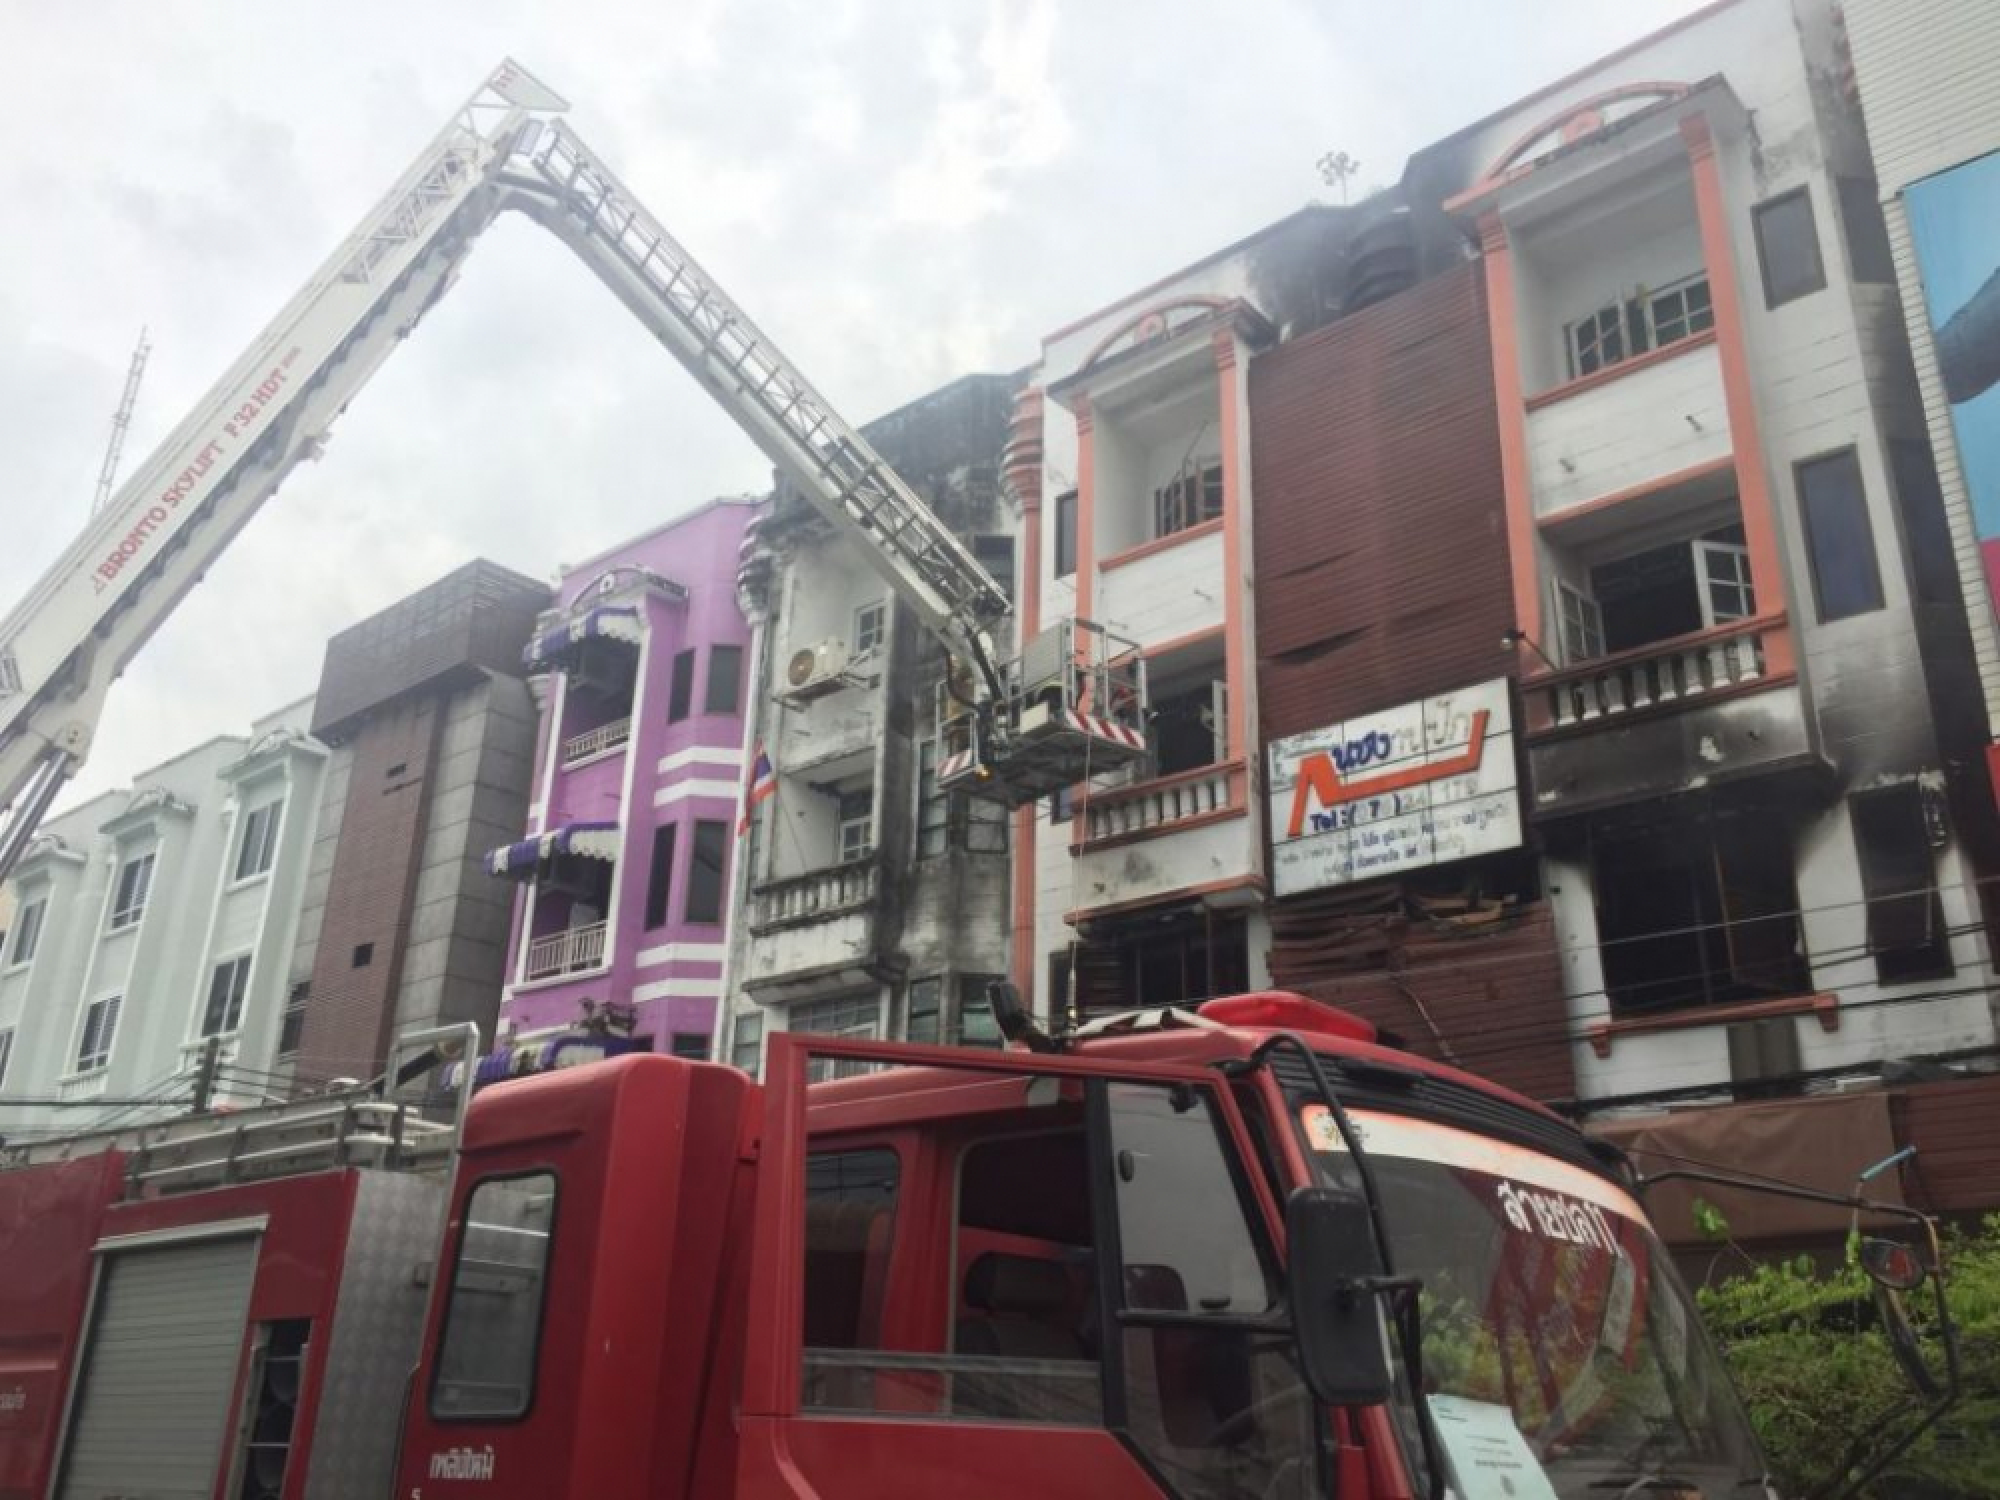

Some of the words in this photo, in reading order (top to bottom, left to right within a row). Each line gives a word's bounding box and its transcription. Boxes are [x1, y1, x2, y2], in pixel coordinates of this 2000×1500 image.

[97, 505, 168, 581] BRONTO
[161, 438, 225, 509] SKYLIFT
[251, 367, 288, 406] HDT
